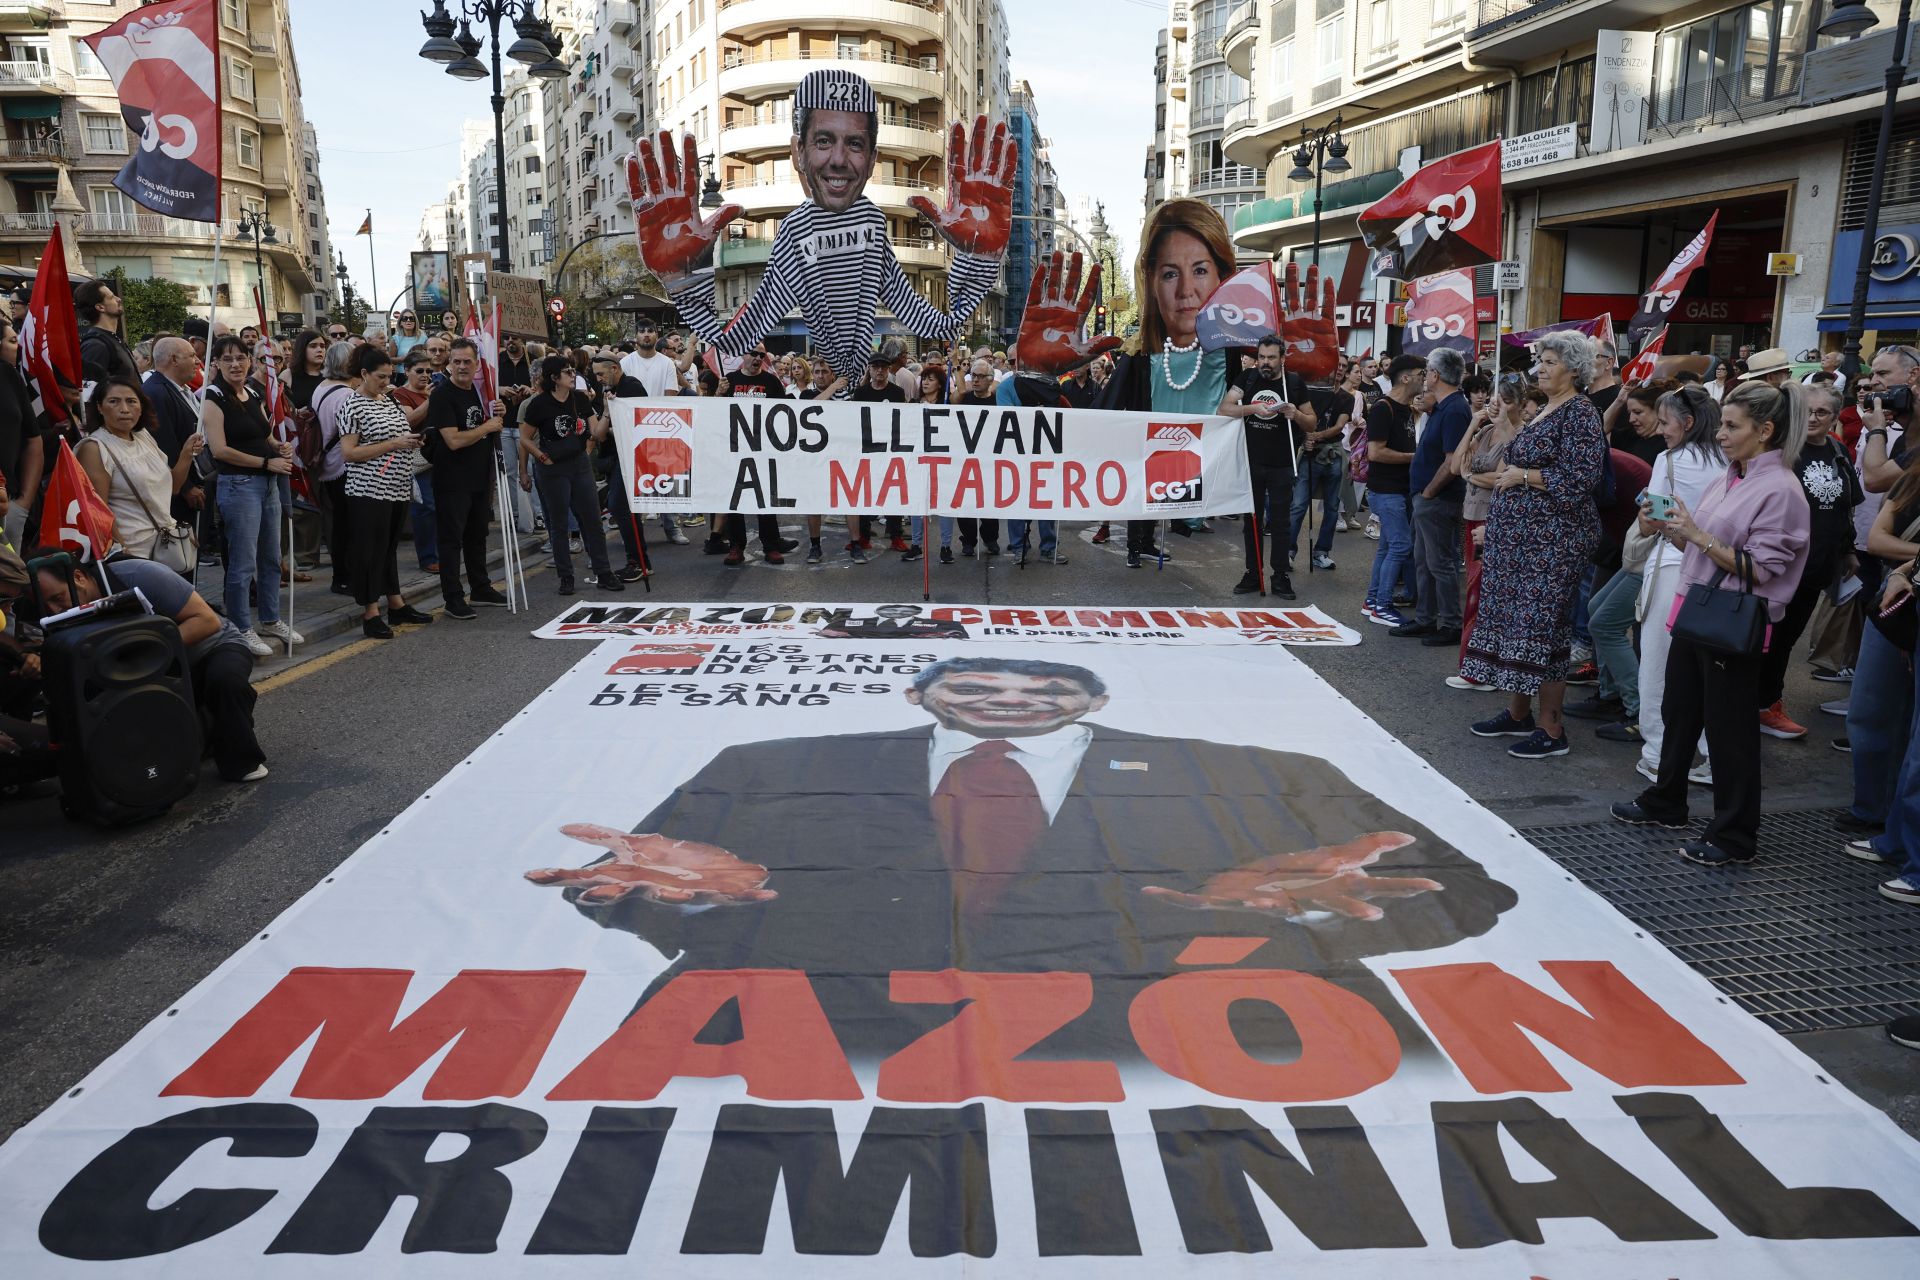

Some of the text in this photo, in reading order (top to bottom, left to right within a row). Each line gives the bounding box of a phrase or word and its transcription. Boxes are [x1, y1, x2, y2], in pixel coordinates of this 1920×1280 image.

[1604, 56, 1648, 68] TENDENZZIA
[828, 83, 860, 101] 228
[1506, 137, 1519, 147] EN
[1521, 126, 1571, 143] ALQUILER
[1506, 157, 1522, 169] 638
[1524, 155, 1539, 165] 841
[1541, 151, 1559, 162] 468
[1811, 185, 1819, 197] 3
[542, 211, 553, 260] HOTEL
[803, 228, 875, 257] CIMINAL
[1871, 241, 1893, 265] La
[1686, 302, 1728, 319] GAES
[729, 402, 1064, 455] NOS LLEVAN
[637, 473, 690, 495] CGT
[728, 455, 1128, 511] AL MATADERO
[1149, 478, 1201, 501] CGT
[930, 607, 1337, 628] CRIMINAL
[718, 642, 804, 654] LES
[711, 652, 939, 664] NOSTRES
[615, 666, 693, 675] CGT
[702, 663, 921, 675] DE FANG
[600, 681, 892, 694] LES SEUES
[588, 692, 831, 706] DE SANG
[159, 936, 1748, 1102] MAZÓN
[37, 1091, 1920, 1261] CRIMINAL
